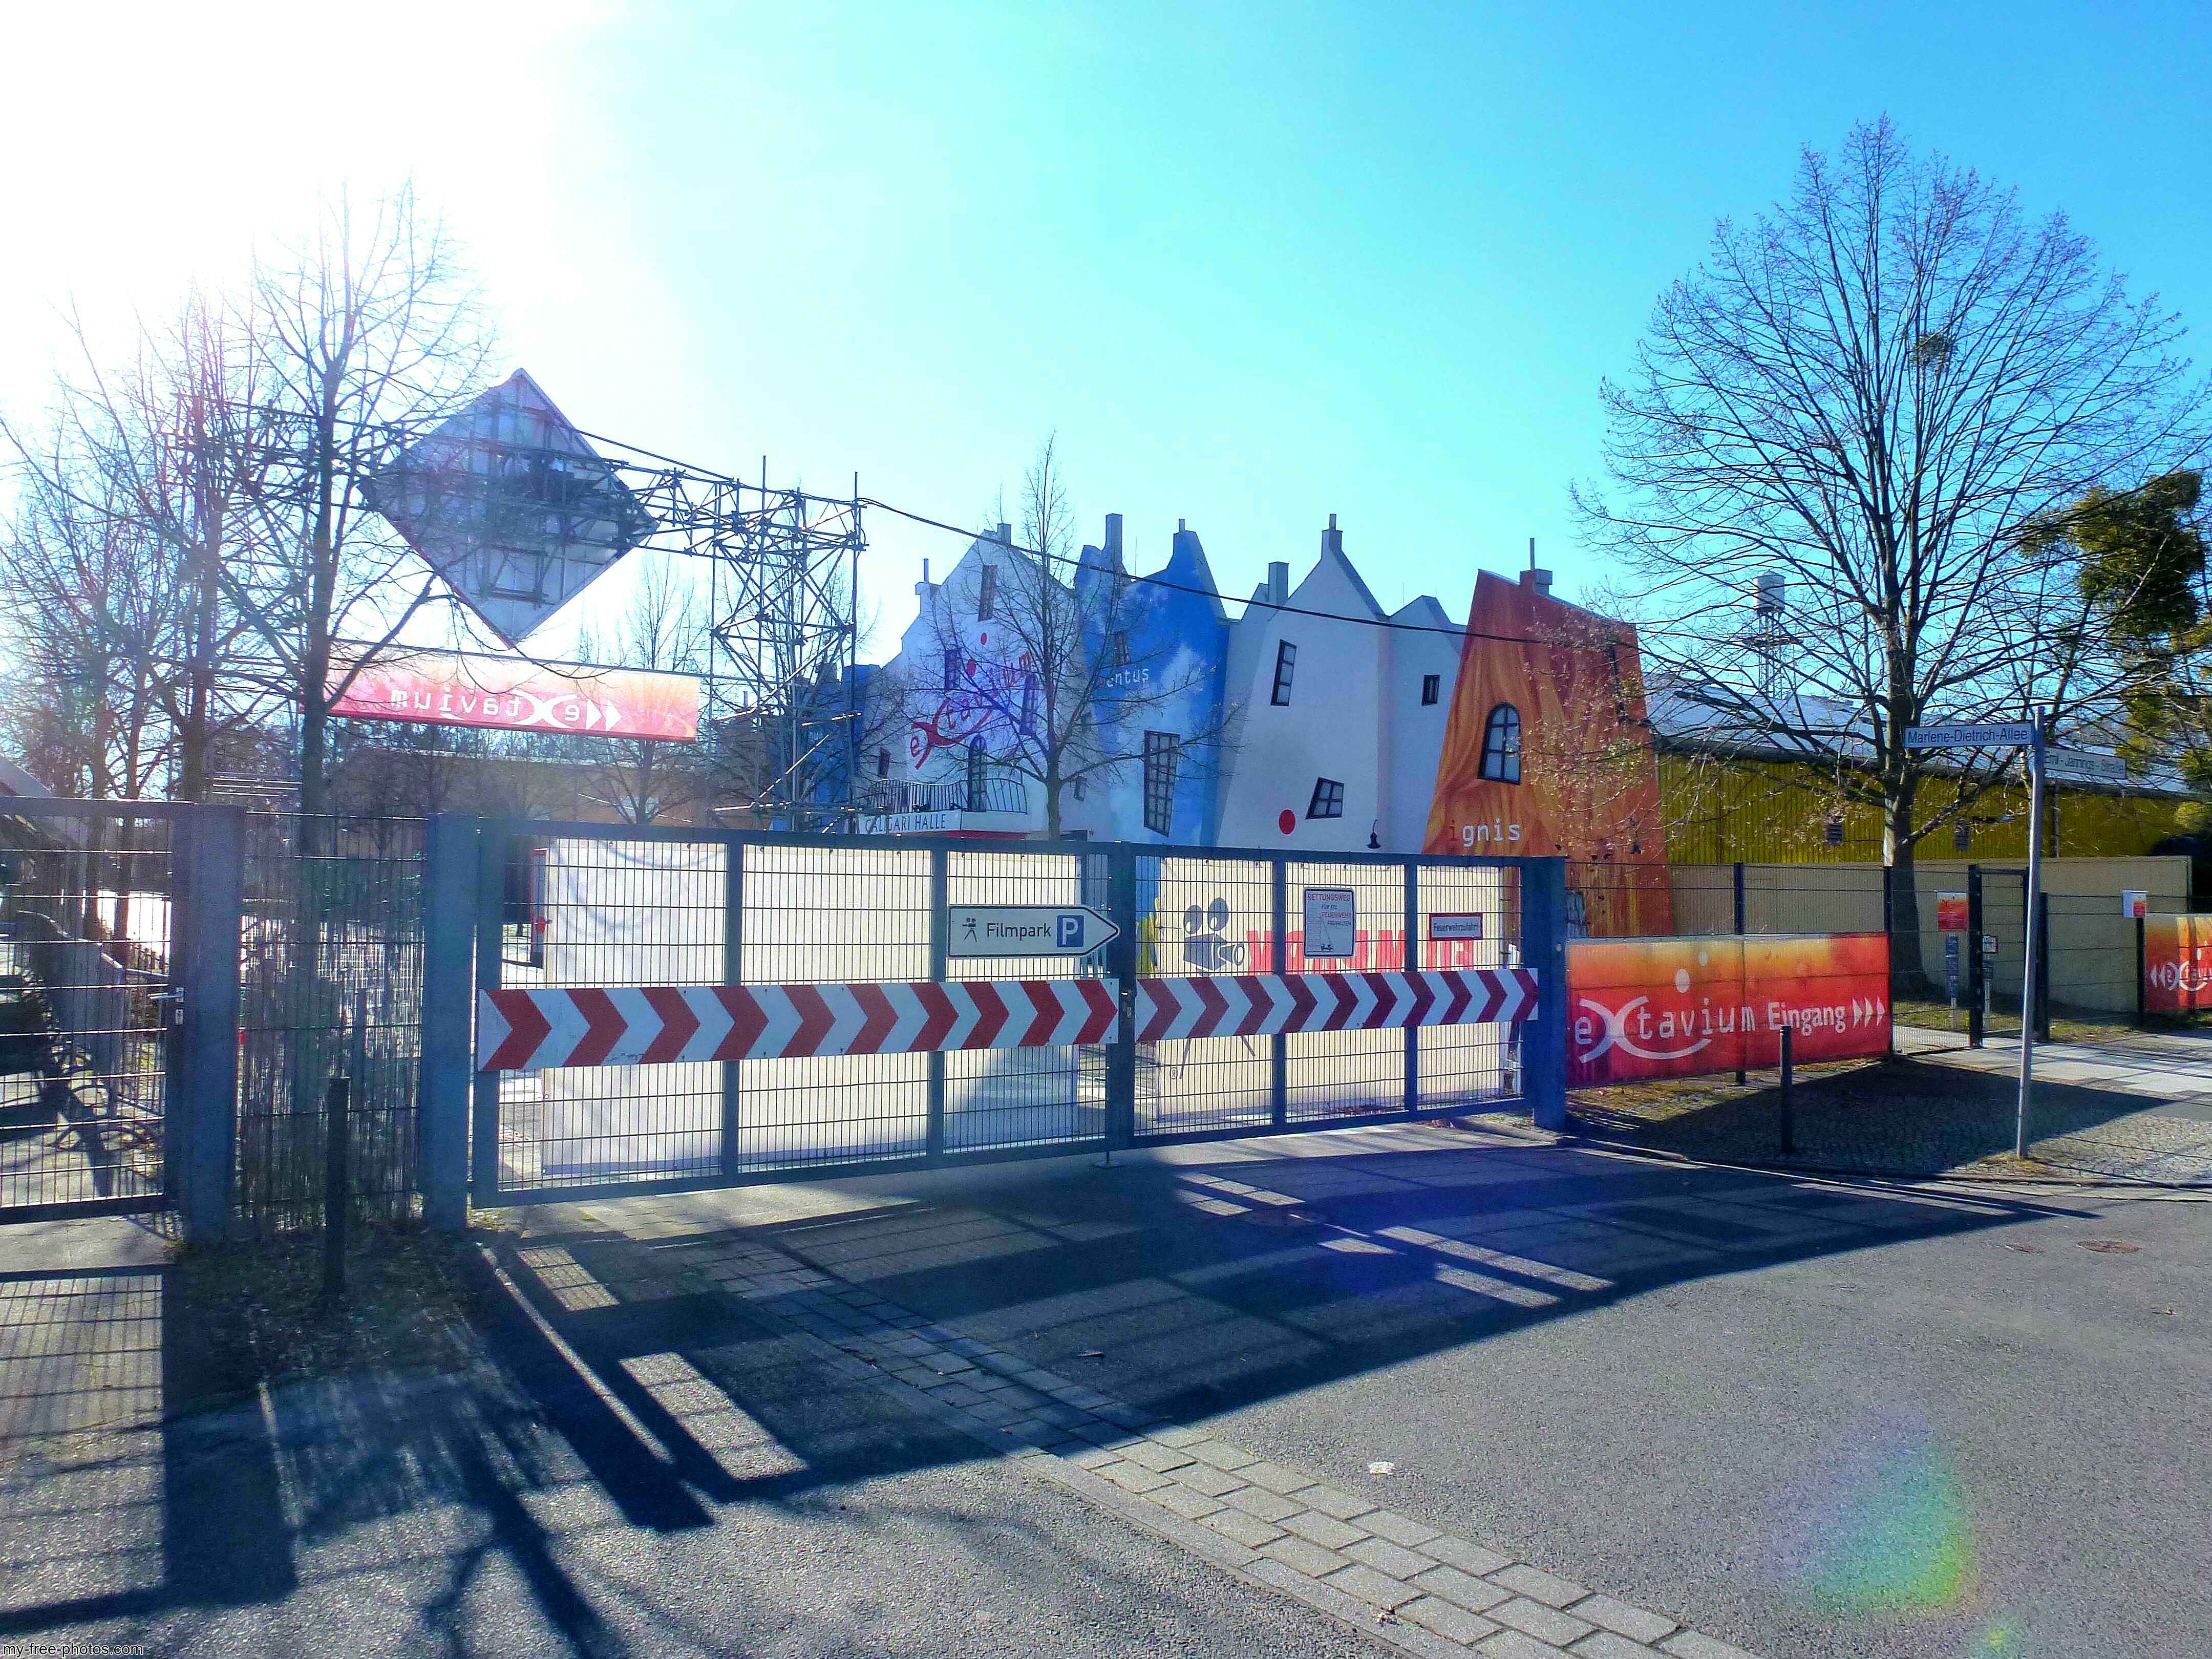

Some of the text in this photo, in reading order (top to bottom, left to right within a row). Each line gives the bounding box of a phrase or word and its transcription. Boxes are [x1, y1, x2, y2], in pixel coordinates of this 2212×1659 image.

[1097, 667, 1149, 688] entus
[1908, 727, 2028, 743] Marlene-Dietrich-Allee
[915, 813, 946, 830] HALLE
[1450, 817, 1520, 847] ignis
[1307, 893, 1351, 901] RETTUNGSWEG
[987, 922, 1051, 941] Filmpark
[1767, 1002, 1845, 1035] Eingang
